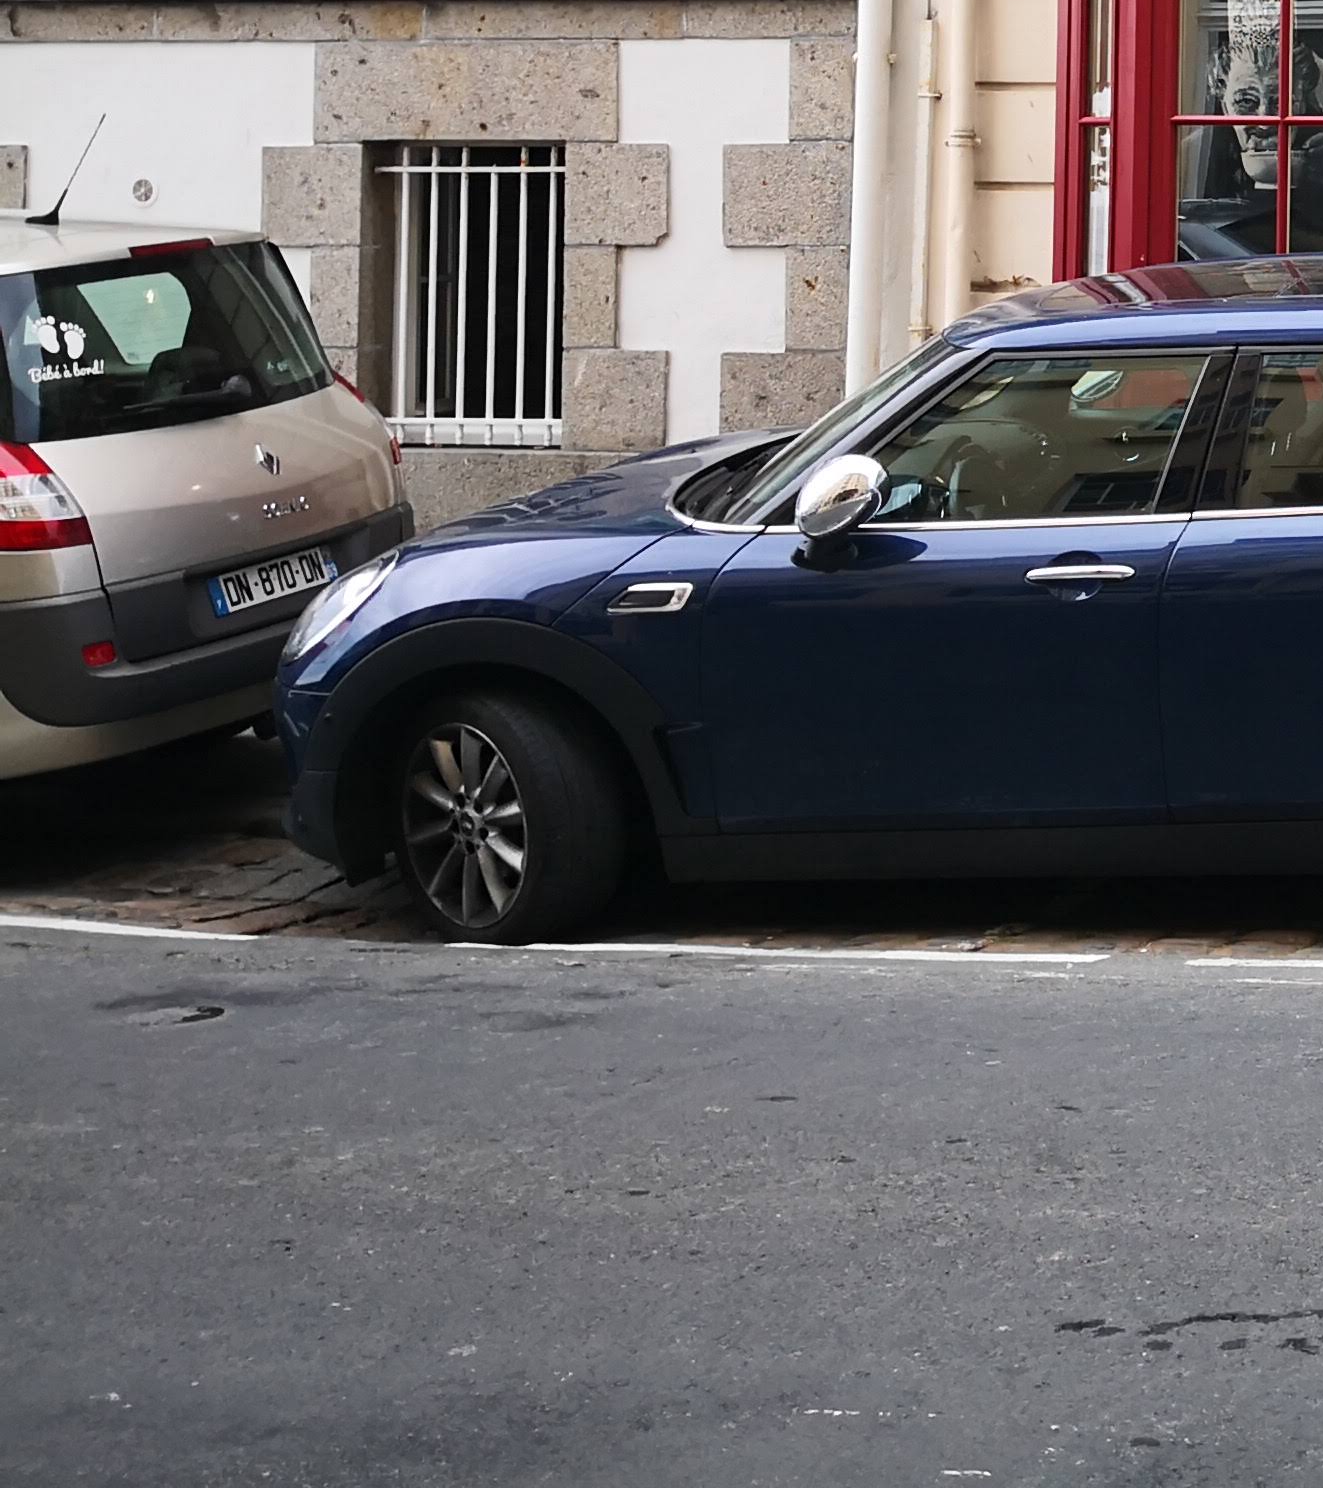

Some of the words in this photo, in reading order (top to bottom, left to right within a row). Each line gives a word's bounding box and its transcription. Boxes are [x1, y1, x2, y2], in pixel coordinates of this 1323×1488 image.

[28, 364, 62, 383] Bébé
[63, 364, 72, 378] à
[73, 359, 104, 377] bord!
